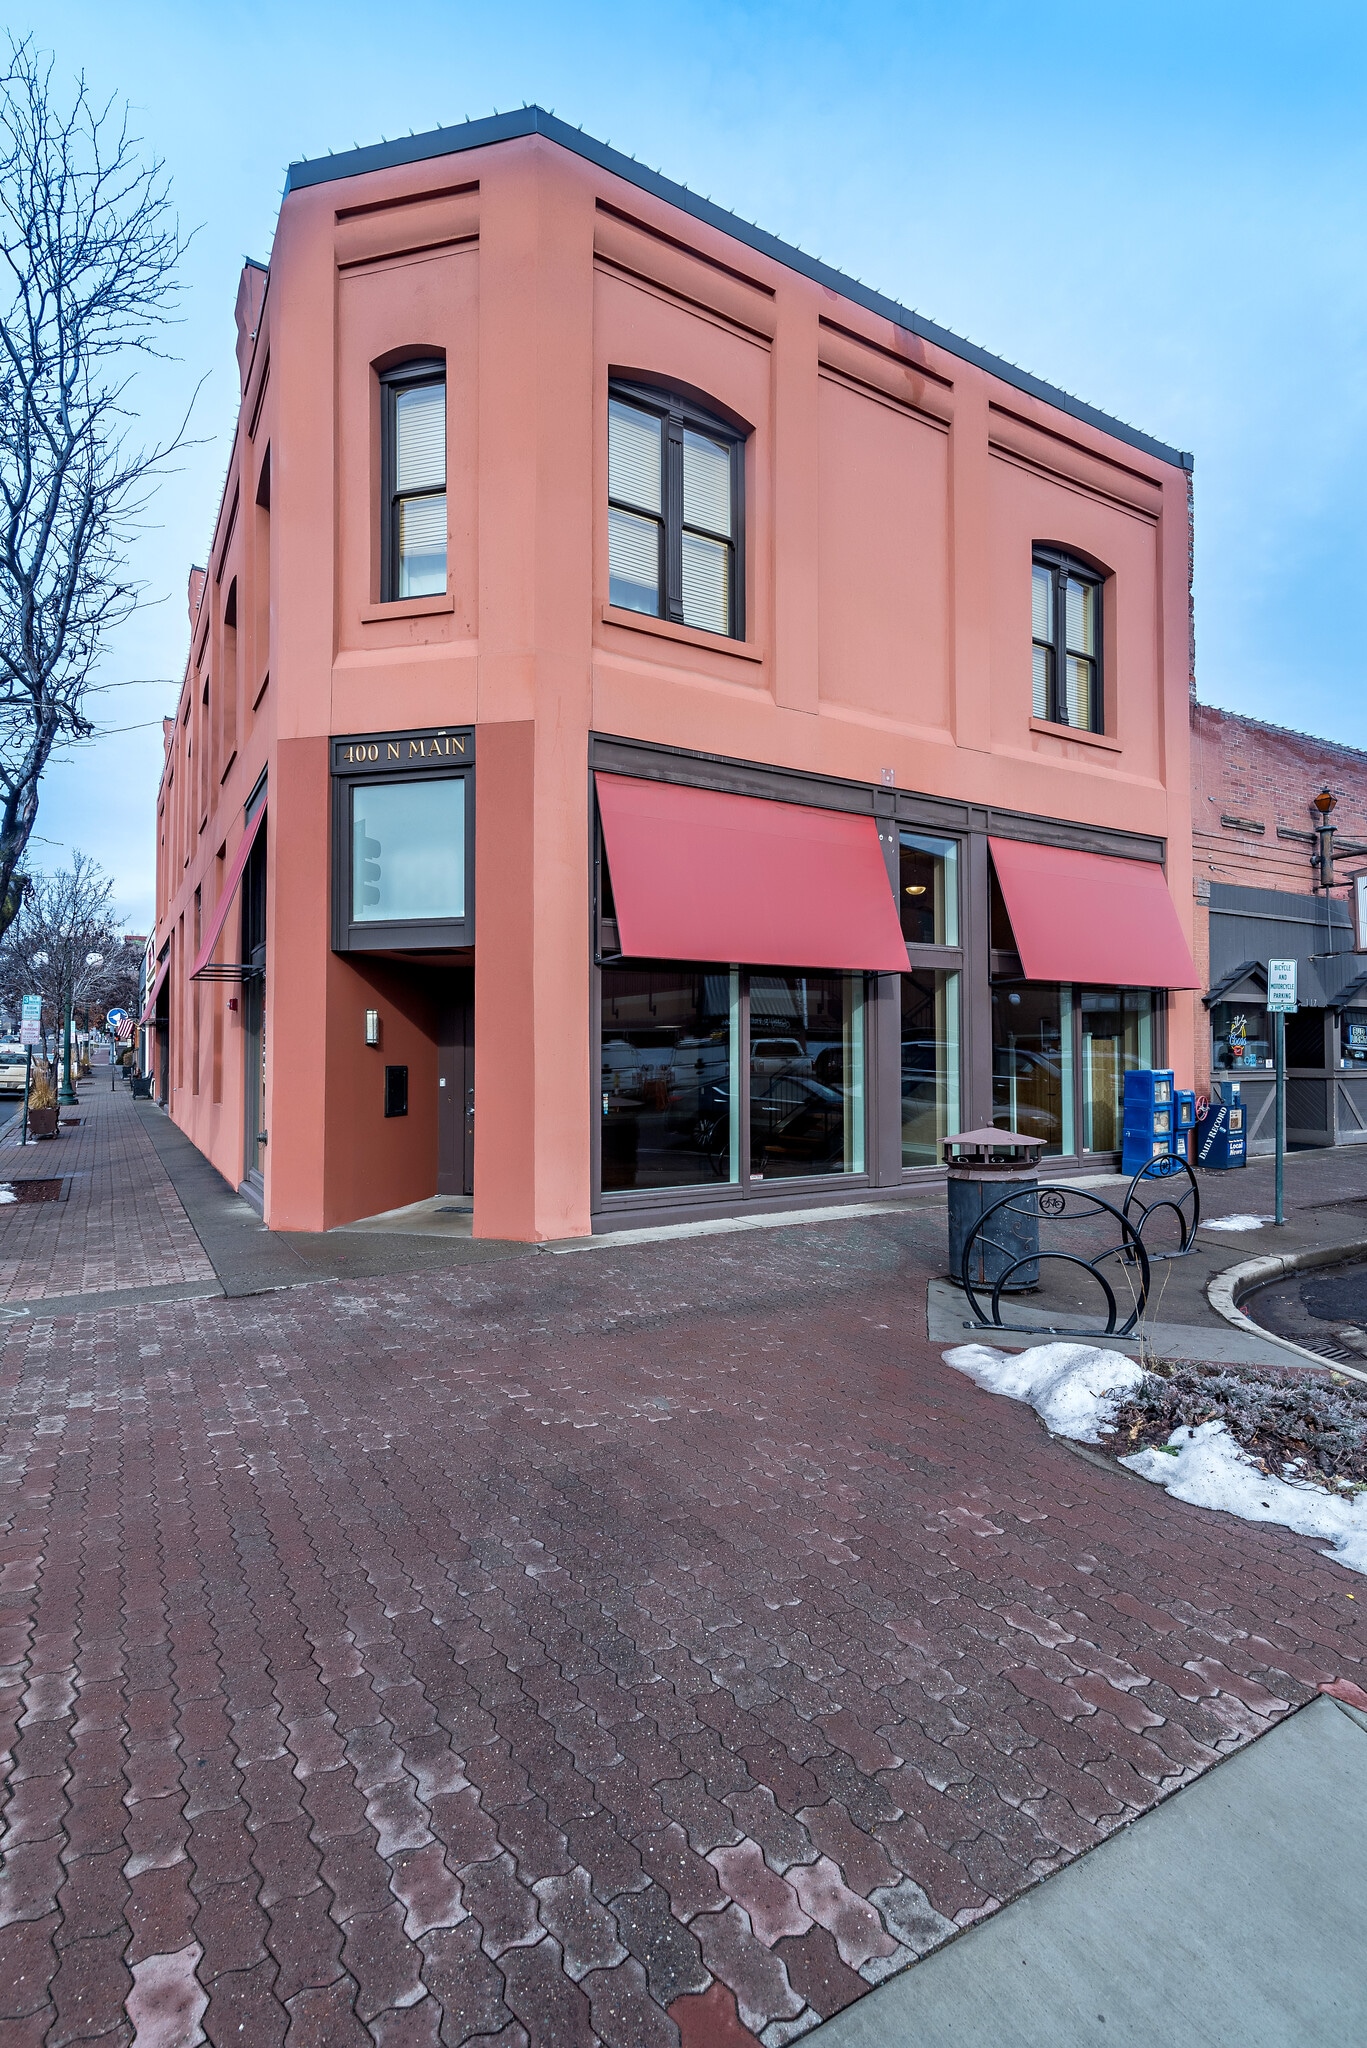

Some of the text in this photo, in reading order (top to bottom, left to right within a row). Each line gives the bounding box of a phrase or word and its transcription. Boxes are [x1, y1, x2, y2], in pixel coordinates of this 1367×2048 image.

[343, 736, 466, 763] 400 N MAIN
[1352, 1027, 1366, 1036] BUD
[1199, 1106, 1228, 1160] DAILY RECORD
[1230, 1142, 1243, 1150] Local
